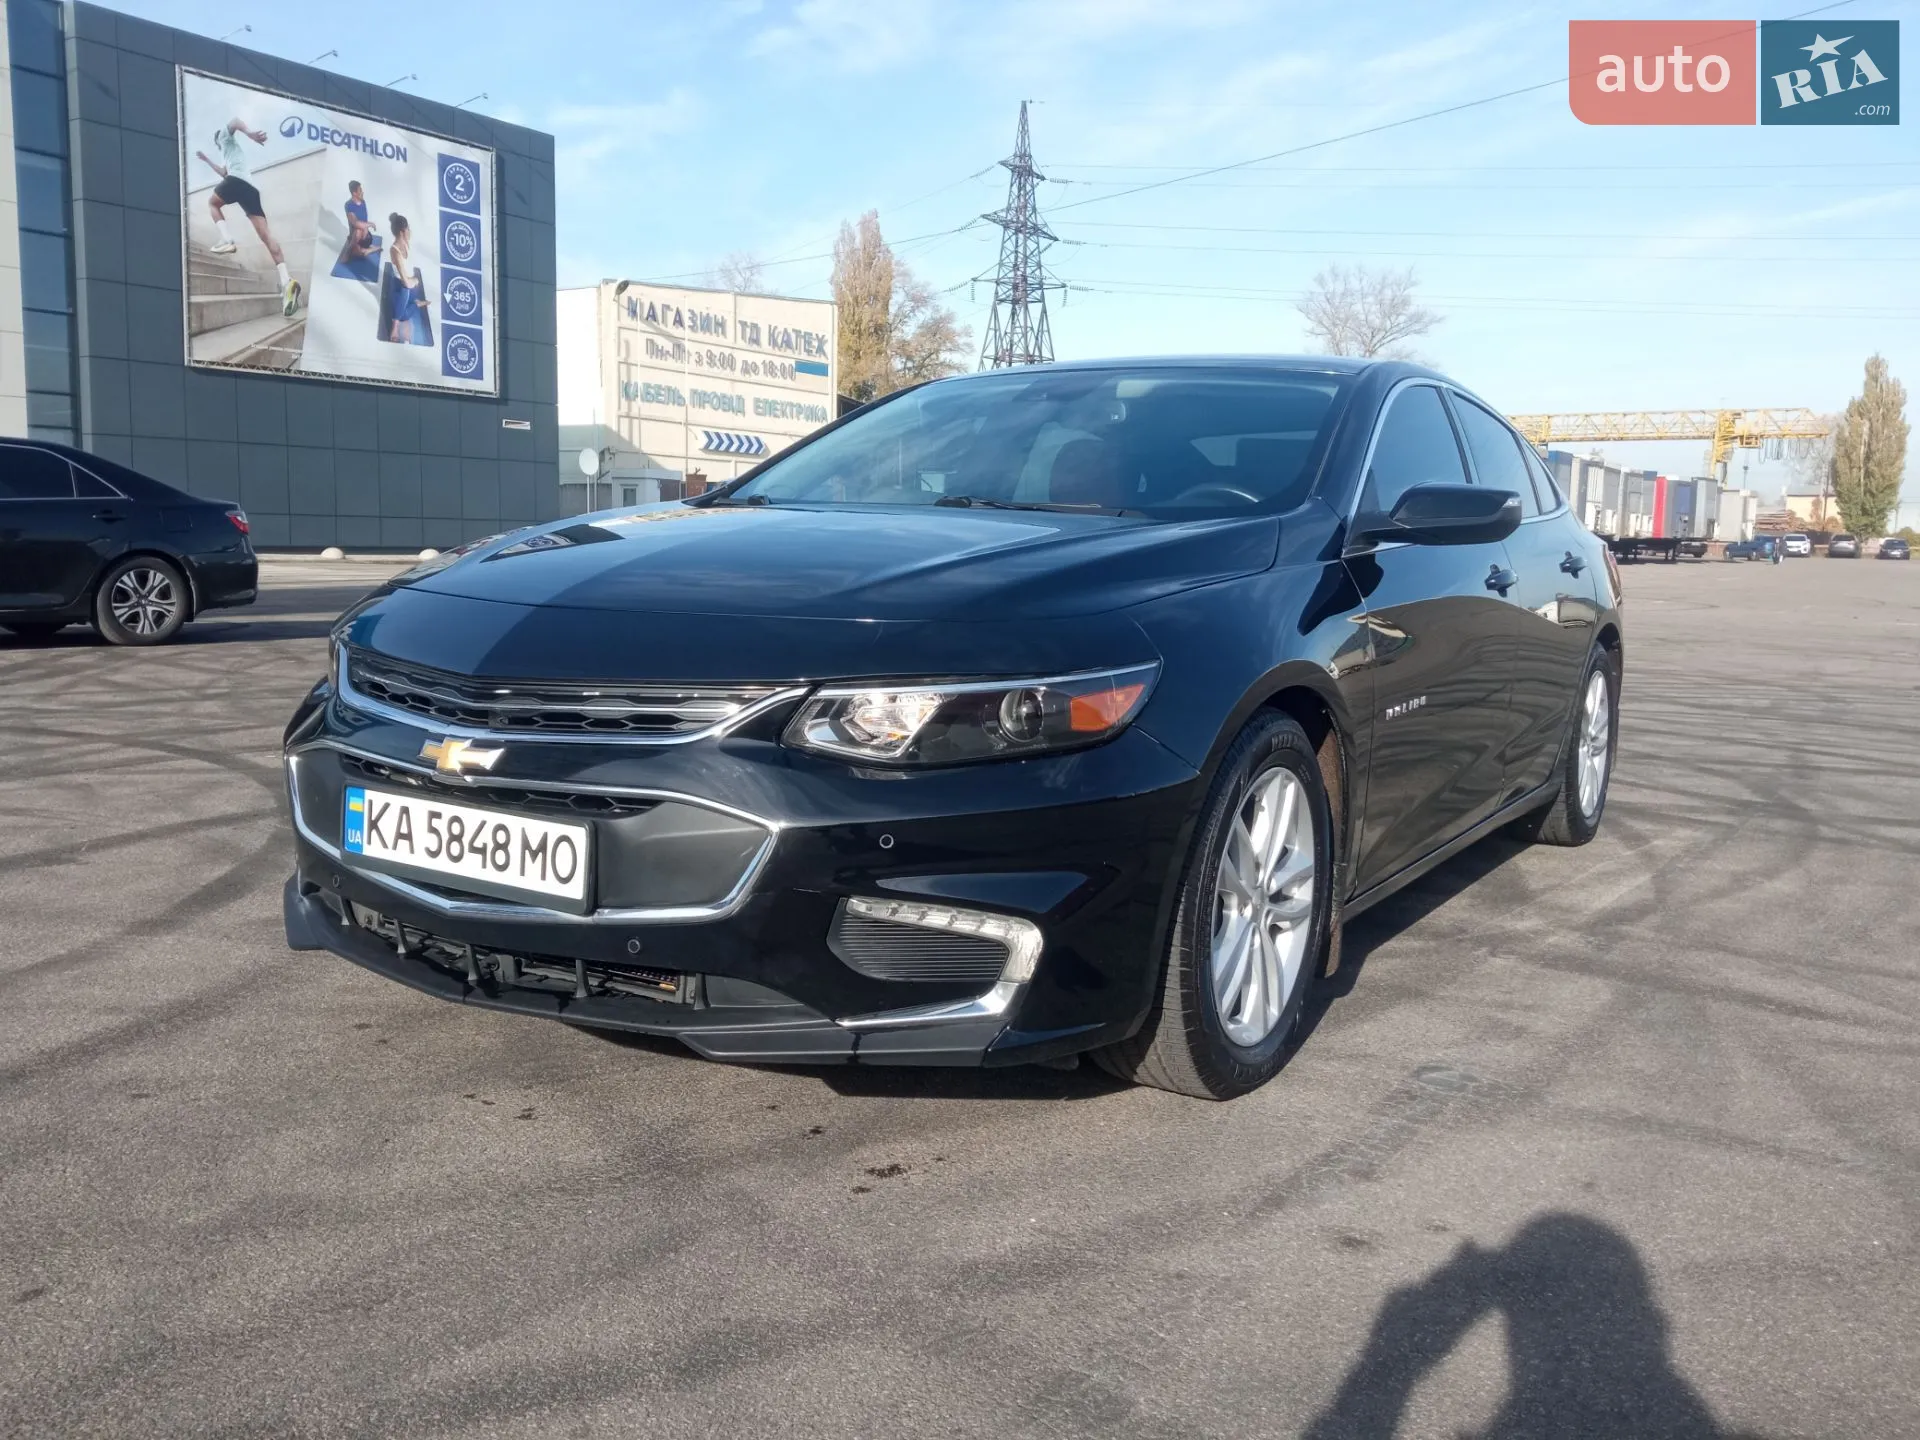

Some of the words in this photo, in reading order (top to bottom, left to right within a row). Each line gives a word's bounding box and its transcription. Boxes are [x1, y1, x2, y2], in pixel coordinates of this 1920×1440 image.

[307, 122, 408, 163] DECATHLON
[455, 174, 465, 191] 2
[450, 232, 474, 247] -10%
[453, 290, 471, 302] 365
[627, 295, 727, 339] МАГАЗИН
[738, 319, 761, 348] ТД
[761, 359, 797, 381] 18:00
[621, 380, 687, 407] КАБЕЛЬ
[689, 388, 745, 418] ПРОВІД
[753, 397, 829, 423] ЕЛЕКТРИКА
[347, 828, 362, 845] UA
[366, 798, 415, 855] KA
[424, 809, 511, 873] 5848
[519, 827, 578, 885] MO
